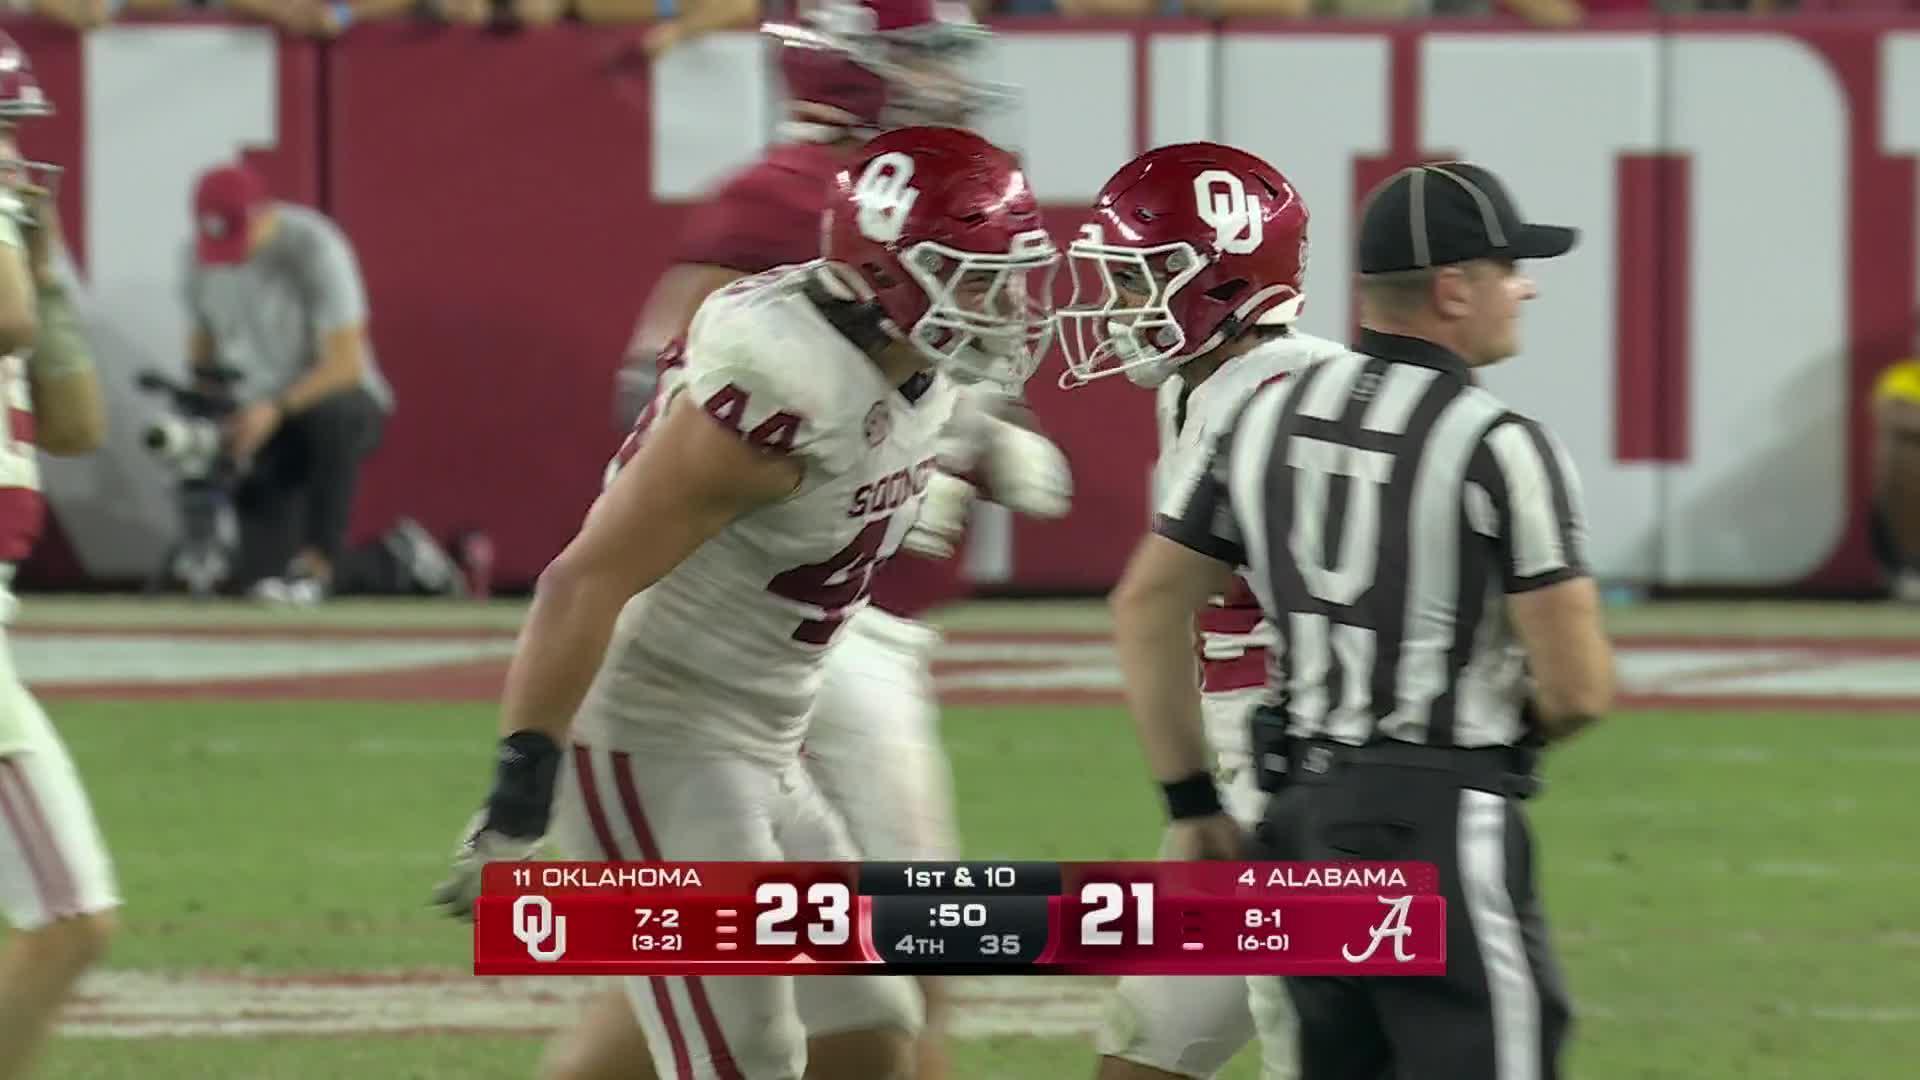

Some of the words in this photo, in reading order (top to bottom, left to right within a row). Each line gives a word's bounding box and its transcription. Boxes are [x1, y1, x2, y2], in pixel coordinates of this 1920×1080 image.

[854, 151, 920, 243] OU
[1193, 170, 1264, 254] OU
[703, 382, 803, 453] 44
[1286, 434, 1398, 607] U
